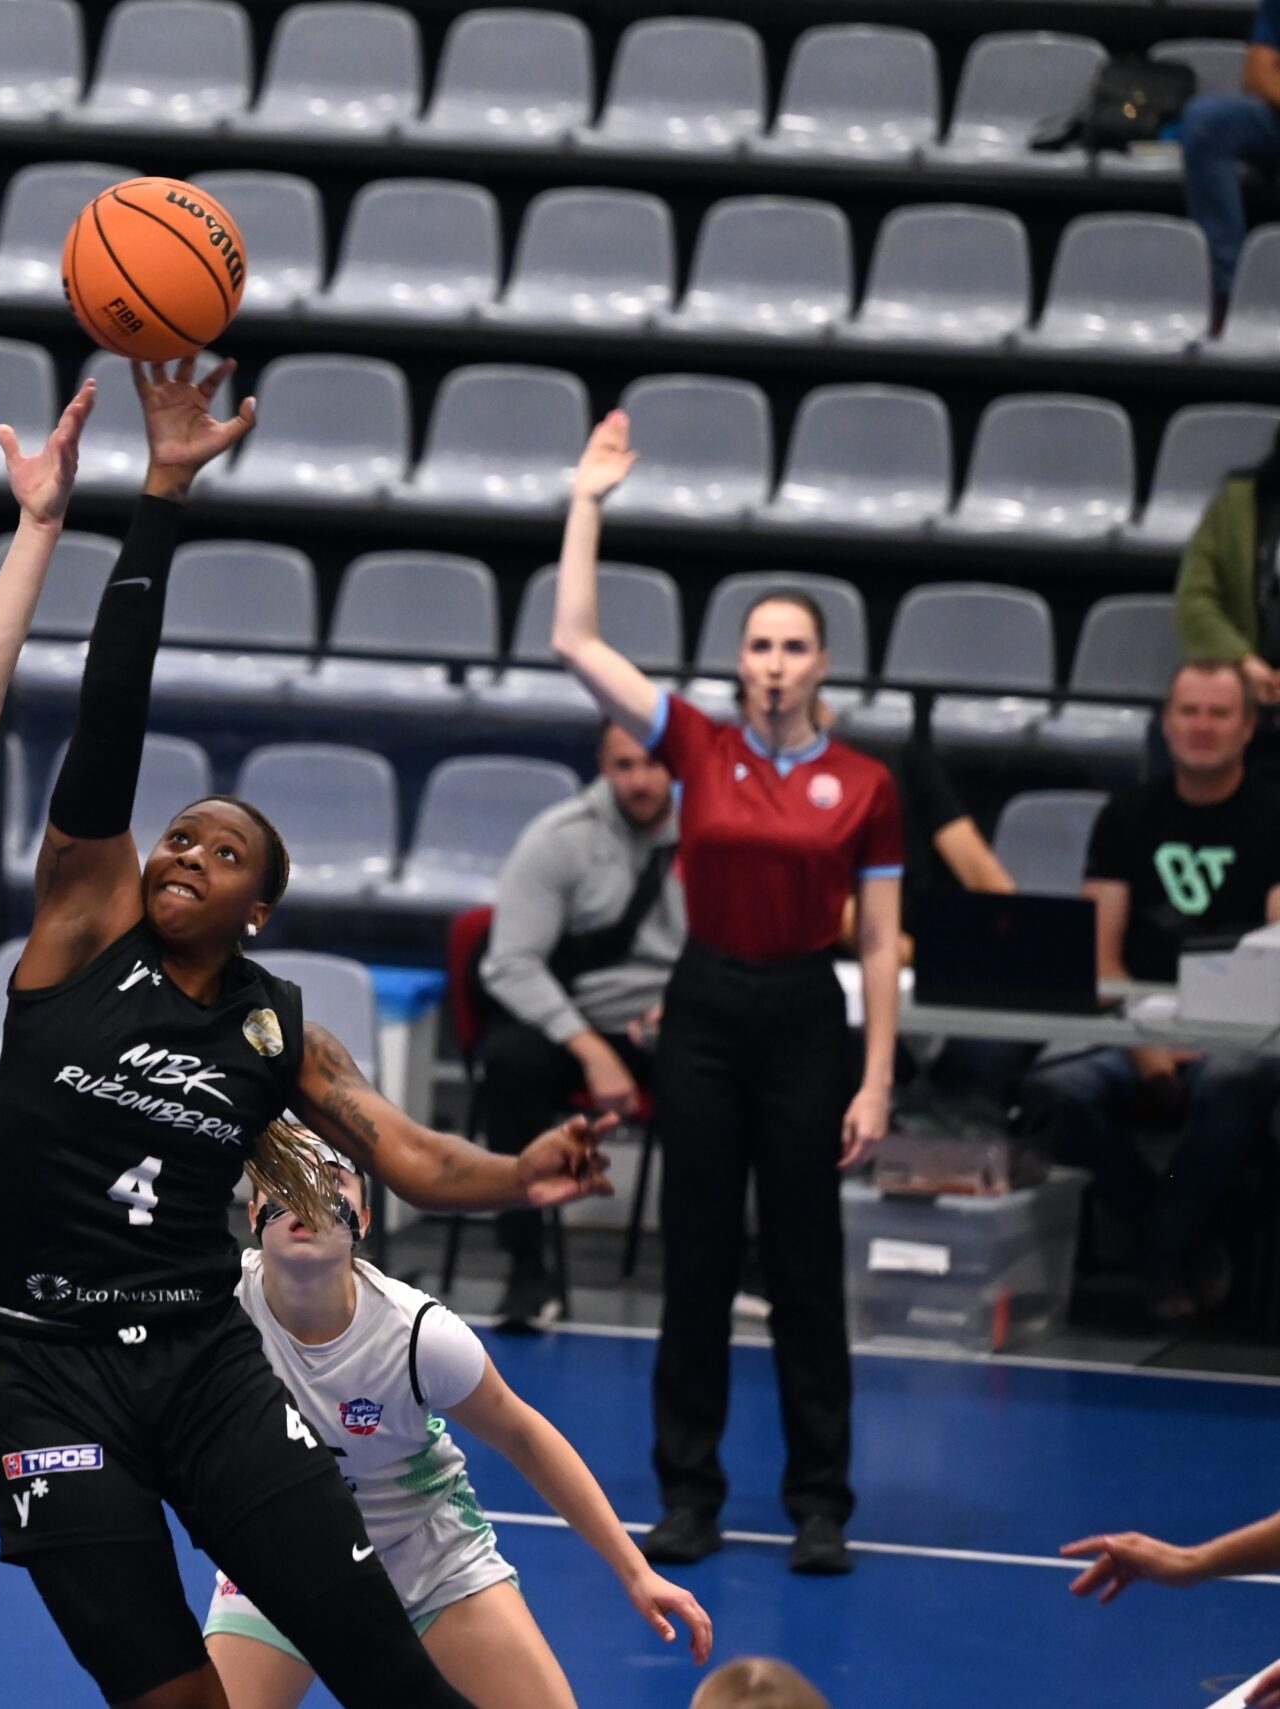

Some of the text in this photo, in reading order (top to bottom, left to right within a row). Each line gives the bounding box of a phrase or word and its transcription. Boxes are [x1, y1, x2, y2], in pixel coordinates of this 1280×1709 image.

[108, 297, 144, 333] FIBA
[119, 1043, 233, 1106] MBK
[54, 1066, 243, 1146] RUŽOMBEROK
[106, 1156, 162, 1225] 4
[285, 1403, 318, 1449] 4
[24, 1449, 96, 1471] TIPOS
